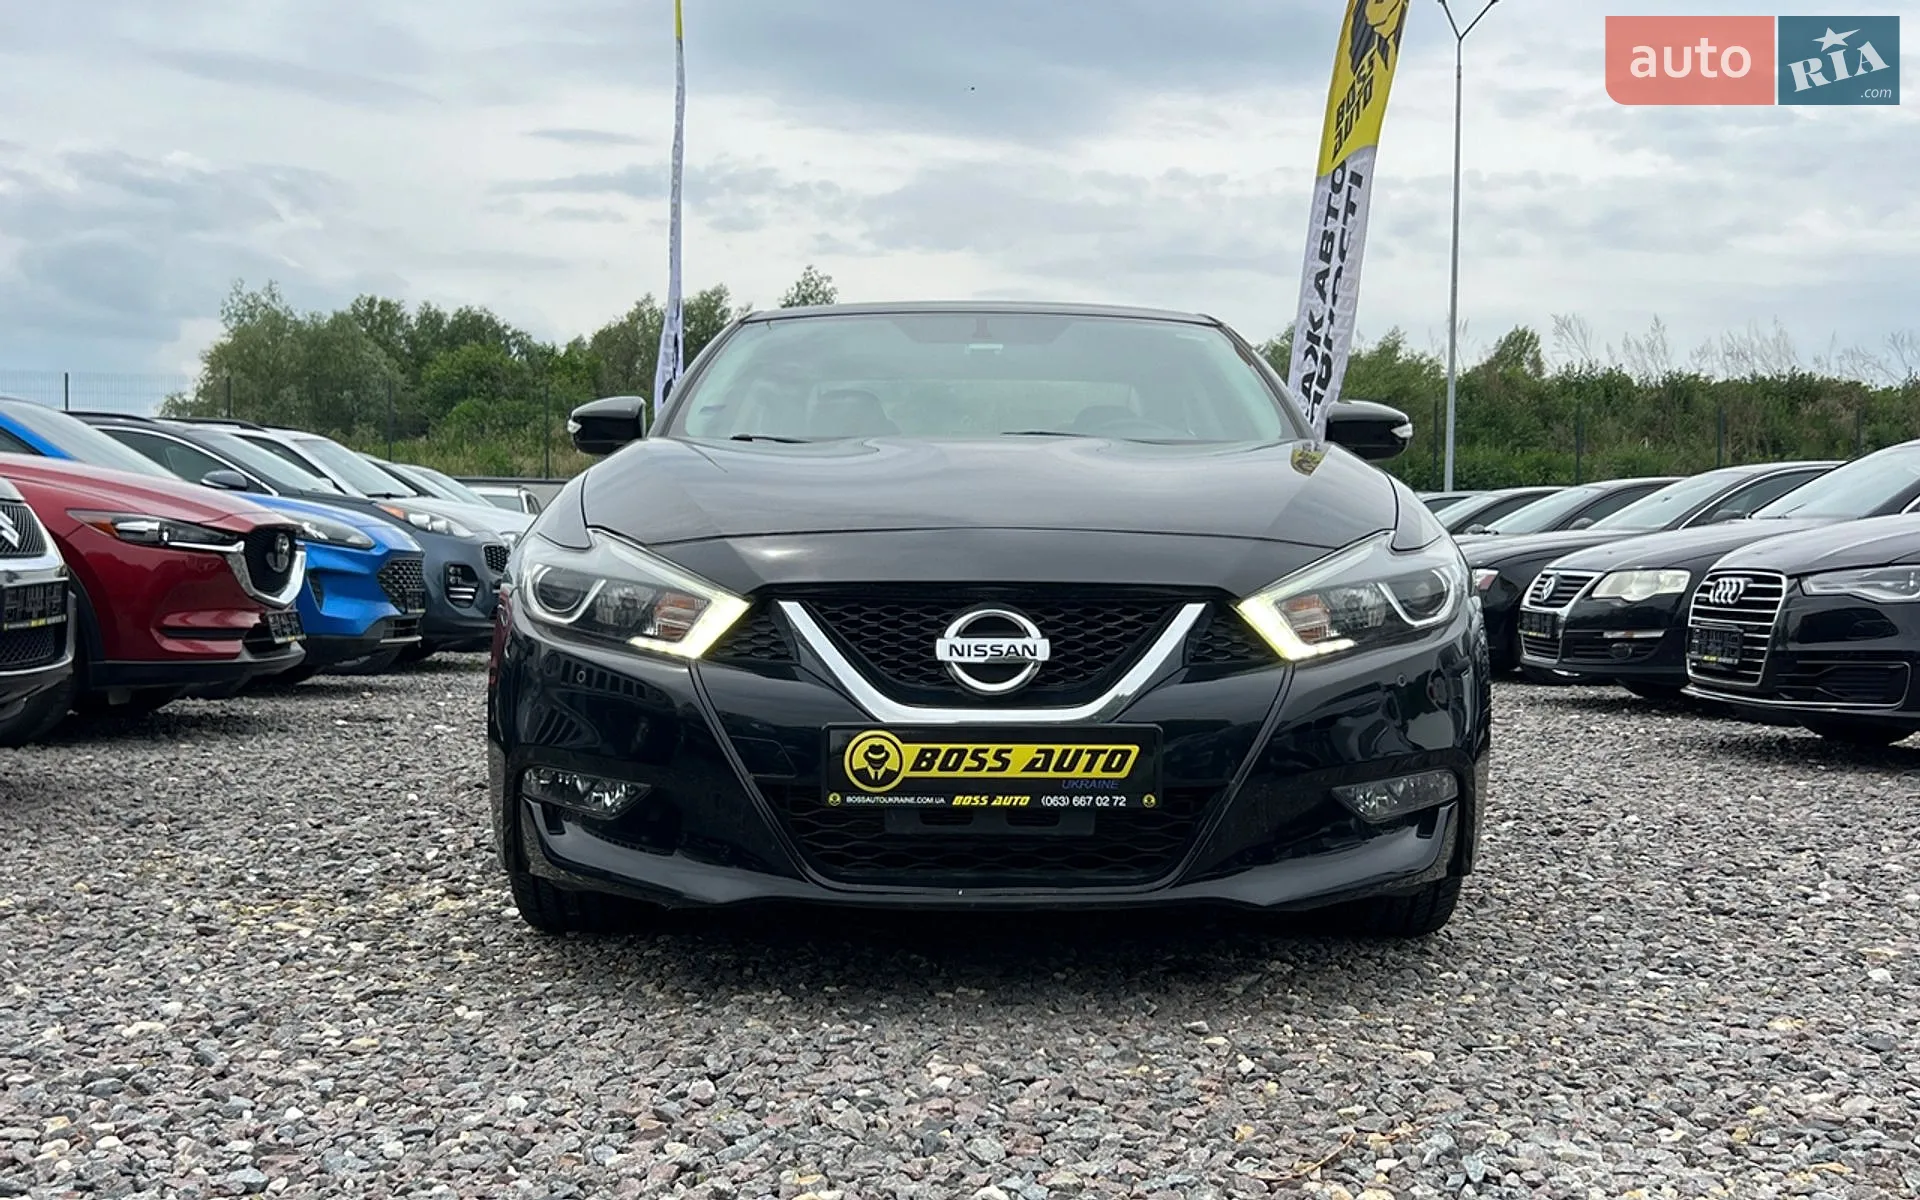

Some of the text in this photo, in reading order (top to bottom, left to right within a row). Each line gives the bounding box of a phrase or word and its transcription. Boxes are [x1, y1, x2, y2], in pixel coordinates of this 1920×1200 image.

[1313, 160, 1347, 305] АВТО
[949, 644, 1038, 657] NISSAN
[909, 747, 1132, 773] BOSS AUTO
[1062, 779, 1119, 790] UKRAINE
[952, 795, 1031, 806] BOSS AUTO
[1041, 795, 1126, 807] (063) 667 02 72
